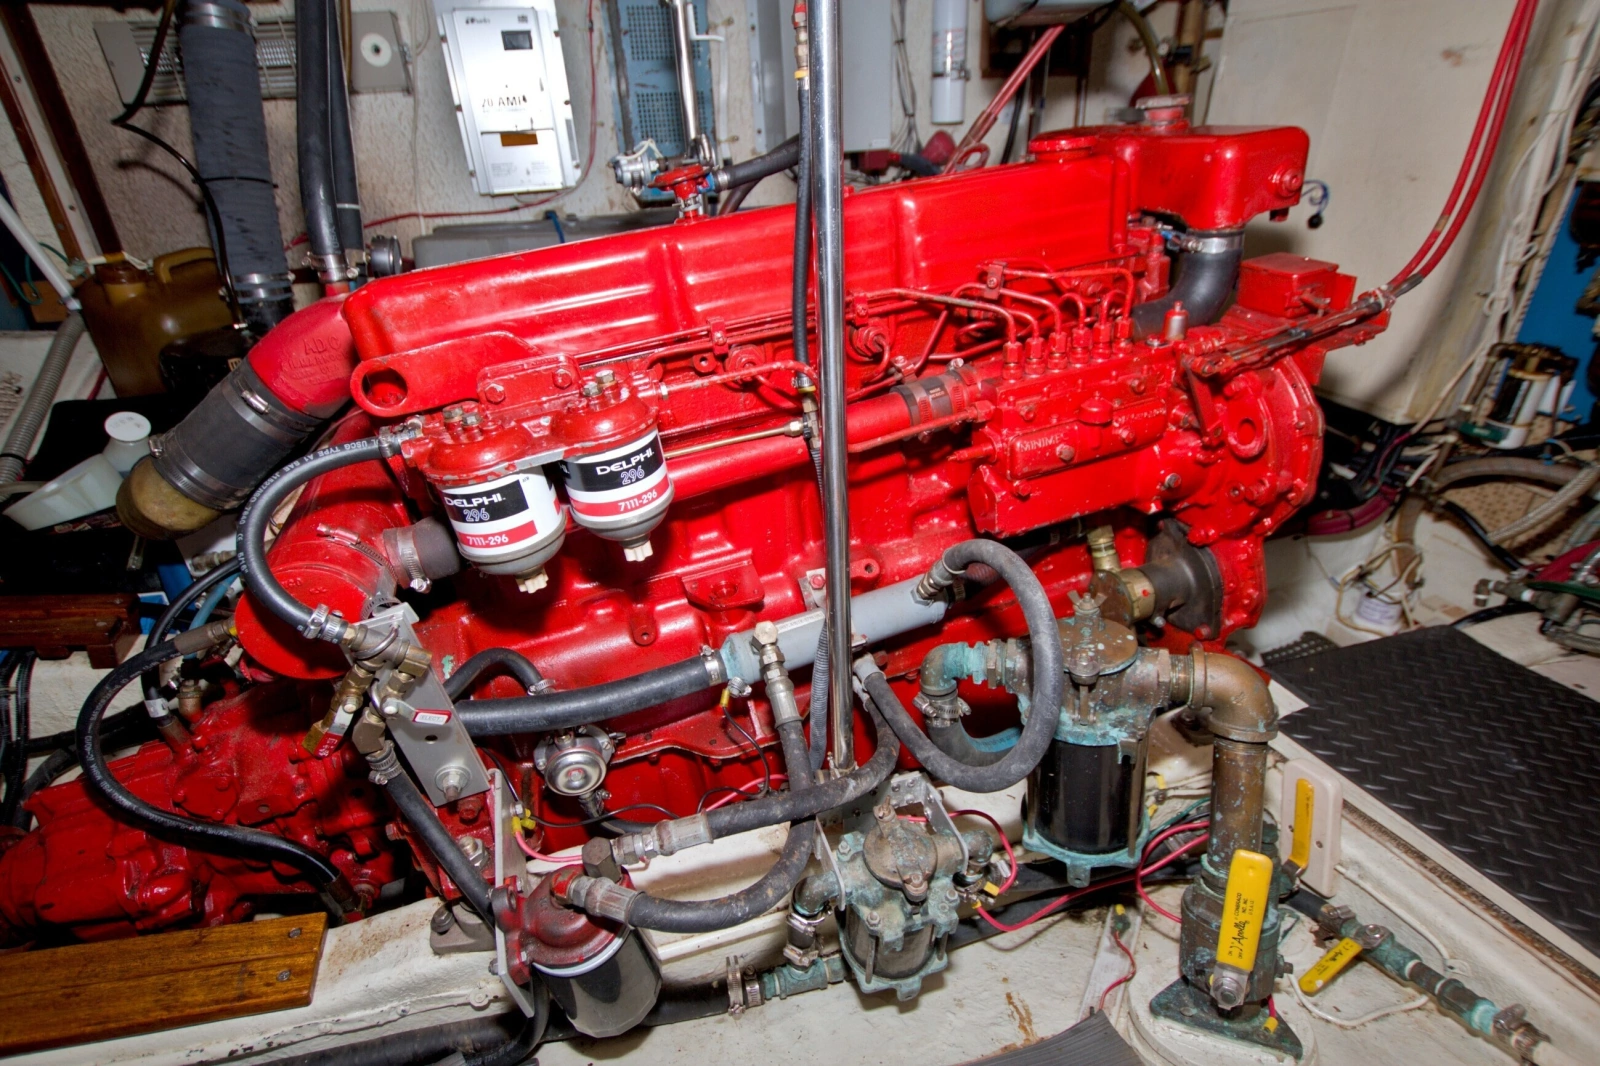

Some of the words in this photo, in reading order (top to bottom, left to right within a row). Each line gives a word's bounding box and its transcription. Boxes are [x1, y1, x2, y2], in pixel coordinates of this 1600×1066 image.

[344, 440, 368, 450] USCG
[1018, 433, 1069, 452] MINIMEC
[304, 454, 316, 463] A1
[318, 446, 341, 458] TYPE
[282, 460, 301, 473] SAE
[596, 447, 653, 475] DELPHI
[620, 465, 645, 485] 296
[444, 493, 503, 507] DELPHI
[618, 490, 658, 511] 7111-296
[463, 508, 490, 522] 296
[466, 534, 509, 546] 7111-296
